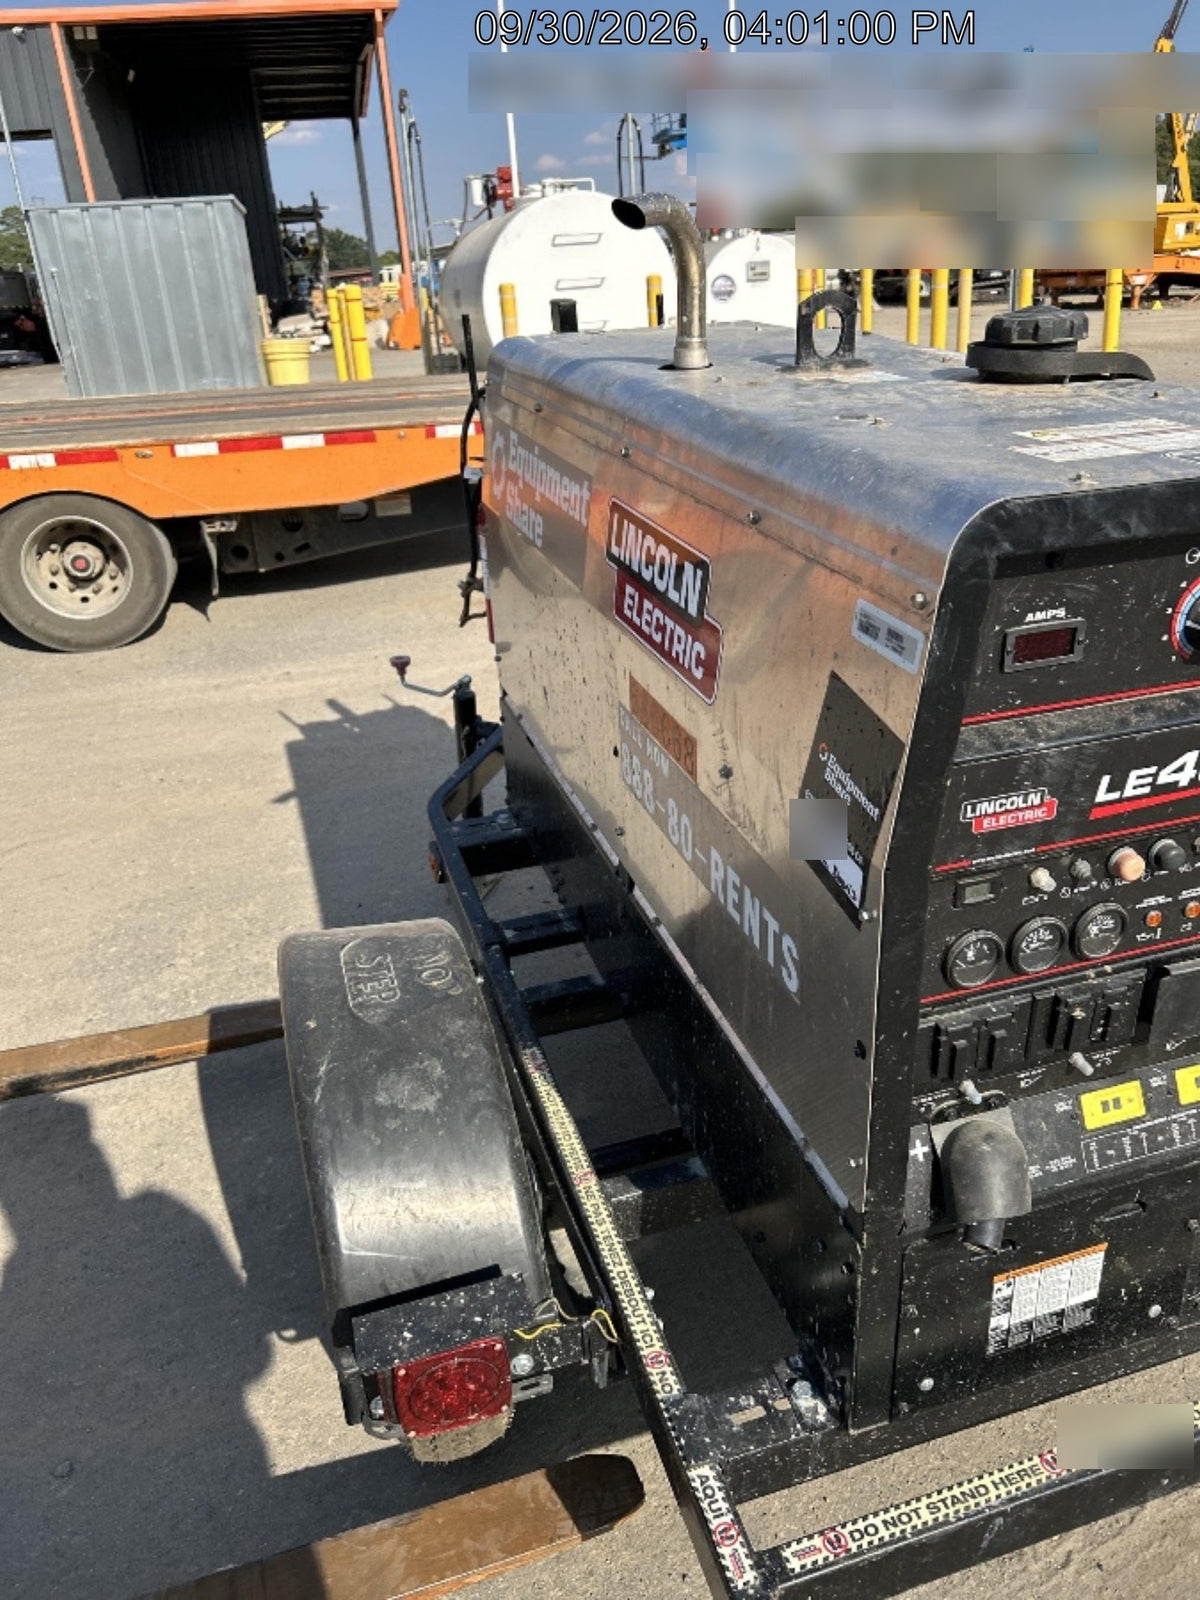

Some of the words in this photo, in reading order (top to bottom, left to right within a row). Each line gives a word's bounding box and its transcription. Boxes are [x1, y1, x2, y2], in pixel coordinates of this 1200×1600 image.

[508, 429, 591, 528] Equipment
[506, 480, 543, 549] Share
[610, 513, 703, 619] LINCOLN
[623, 584, 707, 680] ELECTRIC
[1024, 607, 1066, 622] AMPS
[827, 753, 881, 822] Equipment
[966, 792, 1042, 818] LINCOLN
[1094, 749, 1200, 803] LE4
[982, 807, 1048, 829] ELECTRIC
[616, 1270, 647, 1326] DEBOUT
[639, 1327, 657, 1349] ICI
[656, 1370, 674, 1395] NO
[850, 1522, 879, 1543] DO
[883, 1507, 922, 1532] NOT
[925, 1483, 991, 1517] STAND
[991, 1463, 1045, 1491] HERE
